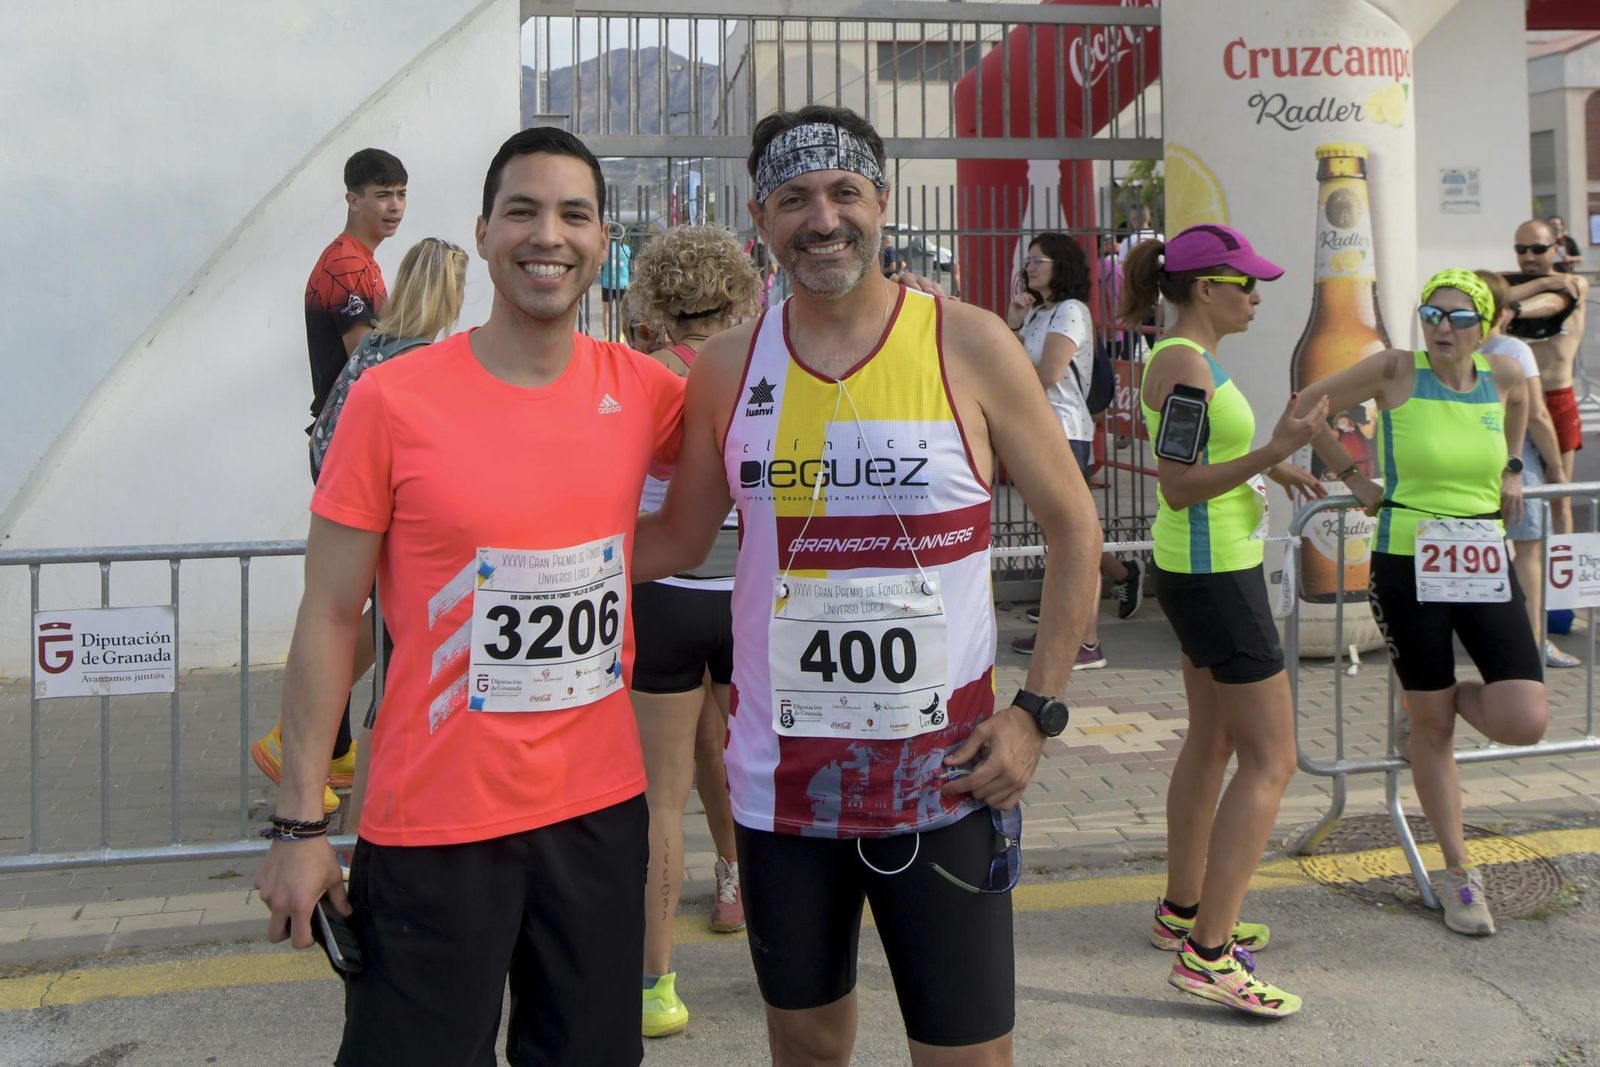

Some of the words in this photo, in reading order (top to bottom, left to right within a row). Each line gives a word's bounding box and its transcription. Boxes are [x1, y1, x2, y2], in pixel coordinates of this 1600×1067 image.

[1247, 91, 1365, 131] Radler
[598, 405, 621, 415] adidas
[745, 405, 774, 417] luanvi
[788, 536, 890, 553] GRANADA
[892, 526, 974, 551] RUNNERS
[1421, 544, 1501, 574] 2190
[484, 590, 620, 660] 3206
[80, 631, 171, 650] Diputación
[81, 650, 100, 665] de
[102, 648, 171, 665] Granada
[800, 627, 917, 684] 400
[81, 672, 132, 684] Avanzamos
